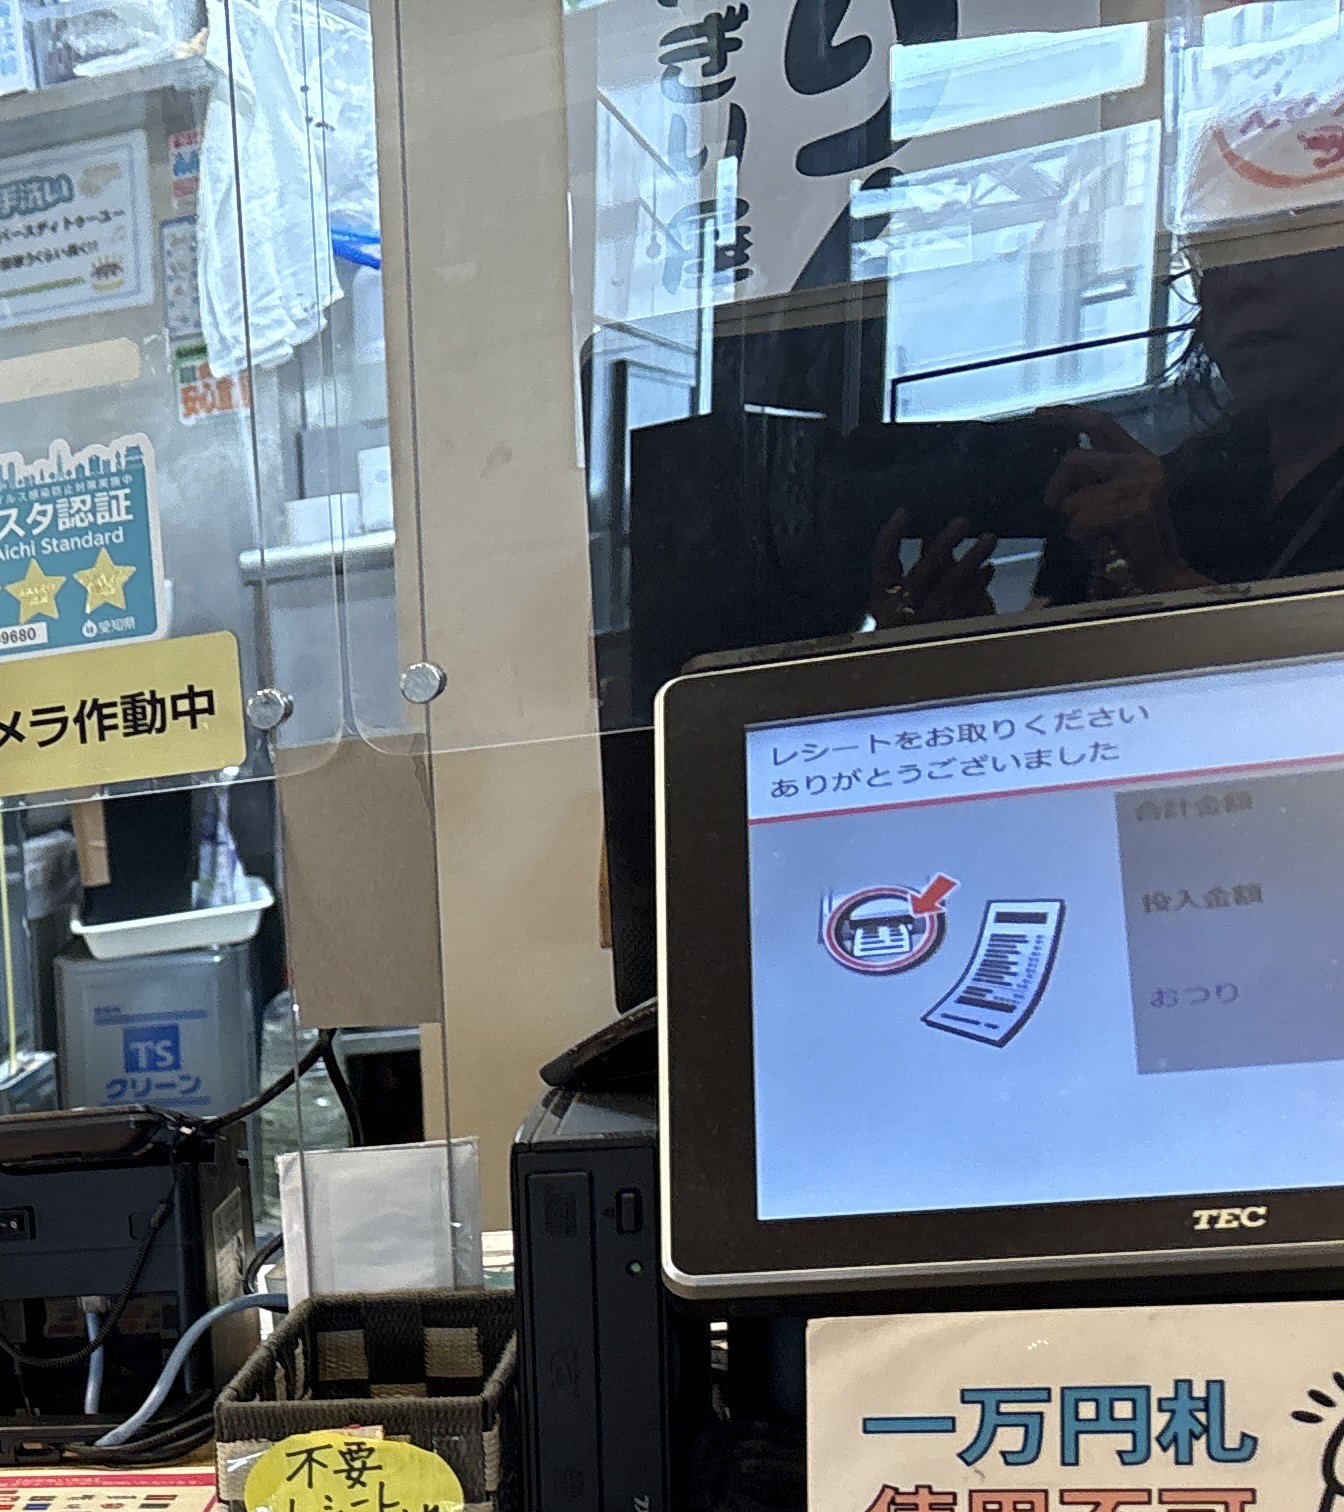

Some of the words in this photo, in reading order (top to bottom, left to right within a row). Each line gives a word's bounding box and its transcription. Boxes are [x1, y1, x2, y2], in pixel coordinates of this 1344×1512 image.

[40, 526, 124, 555] Standard
[771, 704, 1150, 767] レシートをお取りください
[770, 741, 1121, 798] ありがとうございました
[1149, 979, 1241, 1010] おつり
[129, 1039, 176, 1069] TS
[1192, 1206, 1269, 1232] TEC
[862, 1378, 1258, 1466] 一万円札
[286, 1441, 383, 1489] 不要
